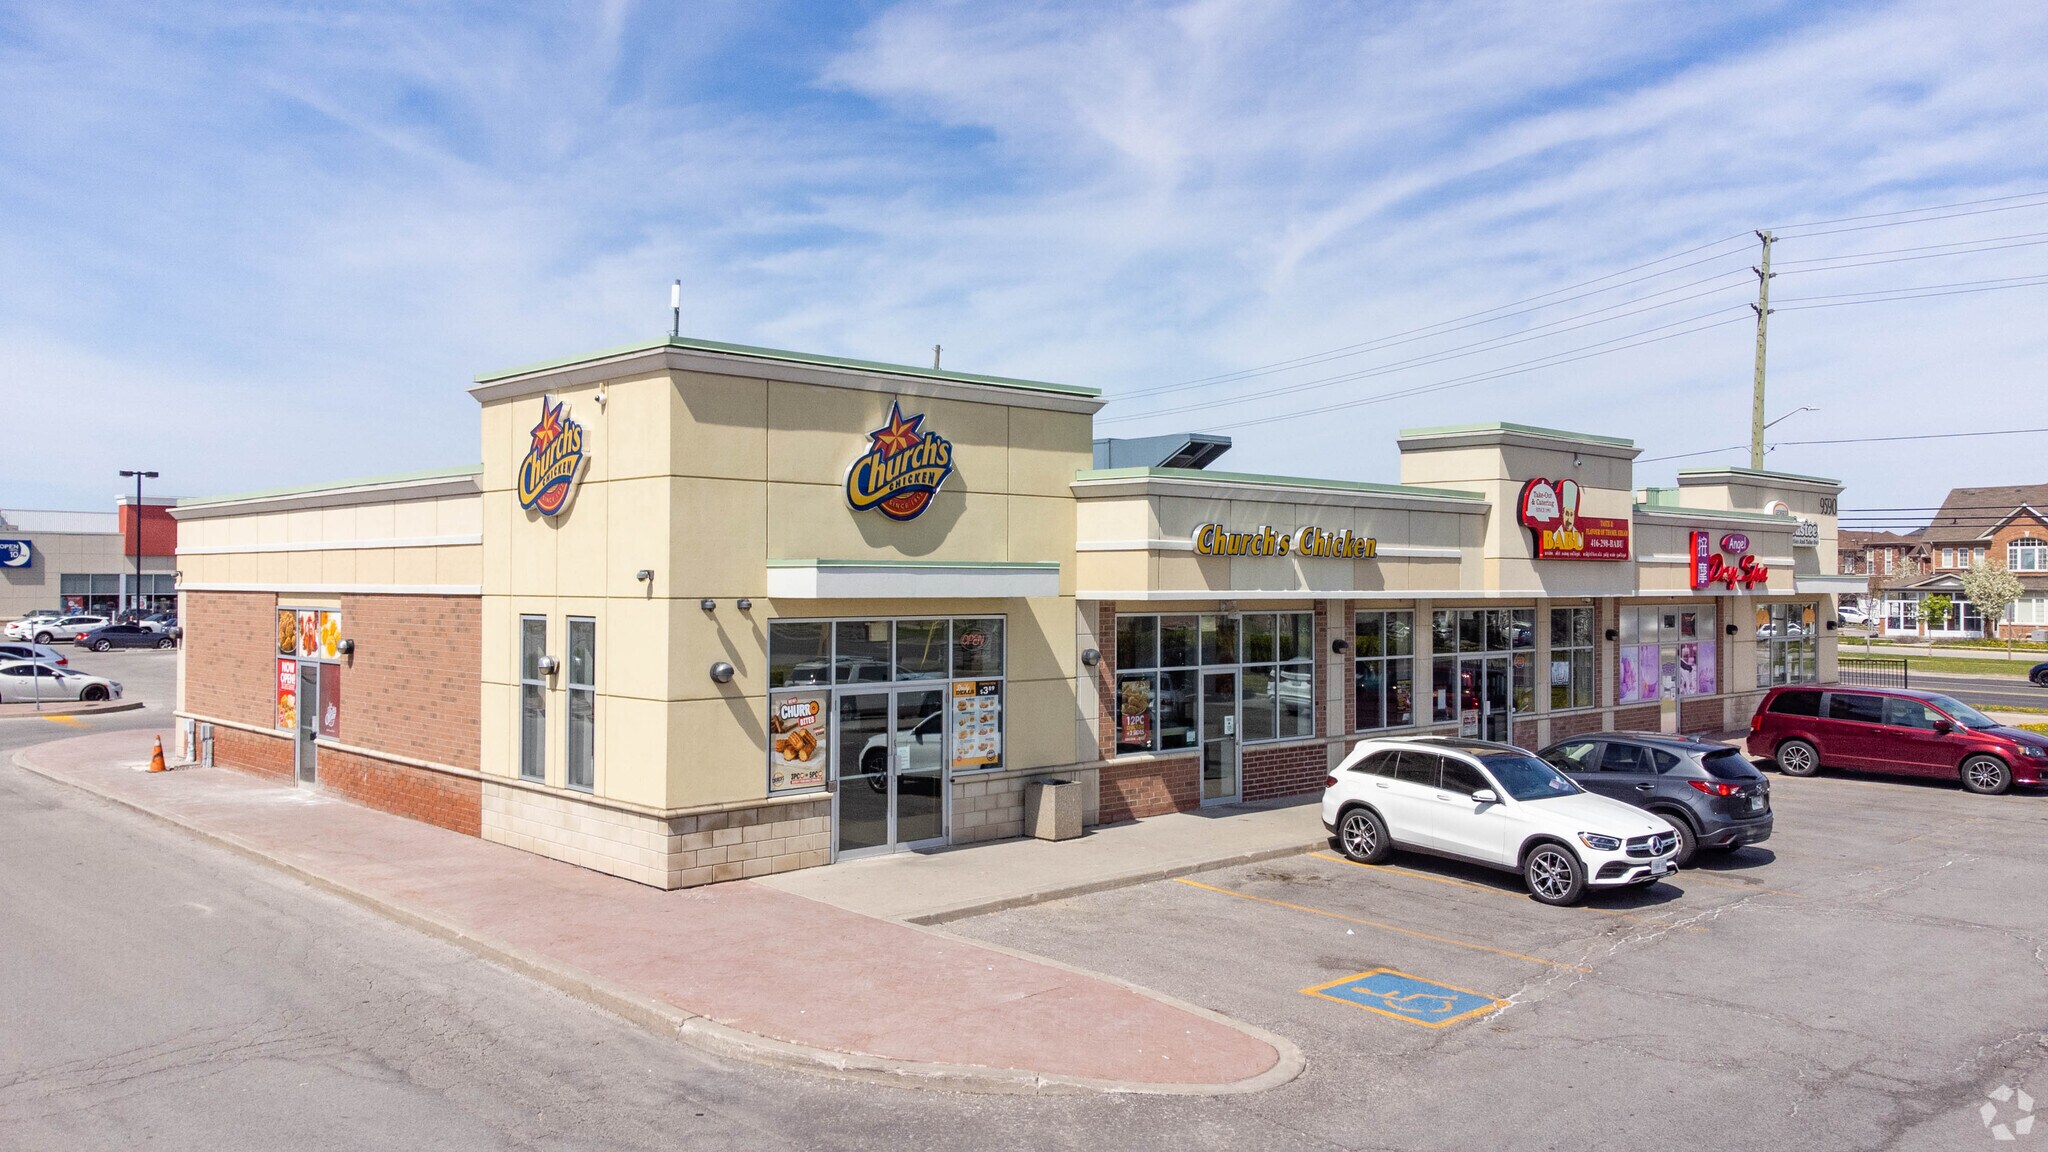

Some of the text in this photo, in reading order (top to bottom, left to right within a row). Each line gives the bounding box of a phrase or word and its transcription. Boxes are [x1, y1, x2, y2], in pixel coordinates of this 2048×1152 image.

[519, 420, 582, 505] Church's
[849, 434, 950, 506] Church's
[543, 460, 572, 486] CHICKEN
[888, 471, 935, 491] CHICKEN
[888, 499, 908, 509] SINCE
[1536, 499, 1555, 508] Catering
[1820, 498, 1837, 515] 9590
[1793, 520, 1819, 538] astee
[1196, 524, 1378, 559] Church's Chicken
[1543, 530, 1584, 550] BABU
[1729, 537, 1747, 553] Angel
[281, 661, 295, 673] NOW
[781, 701, 819, 720] CHURRO
[799, 716, 815, 726] BITES
[1126, 715, 1144, 726] 12PC
